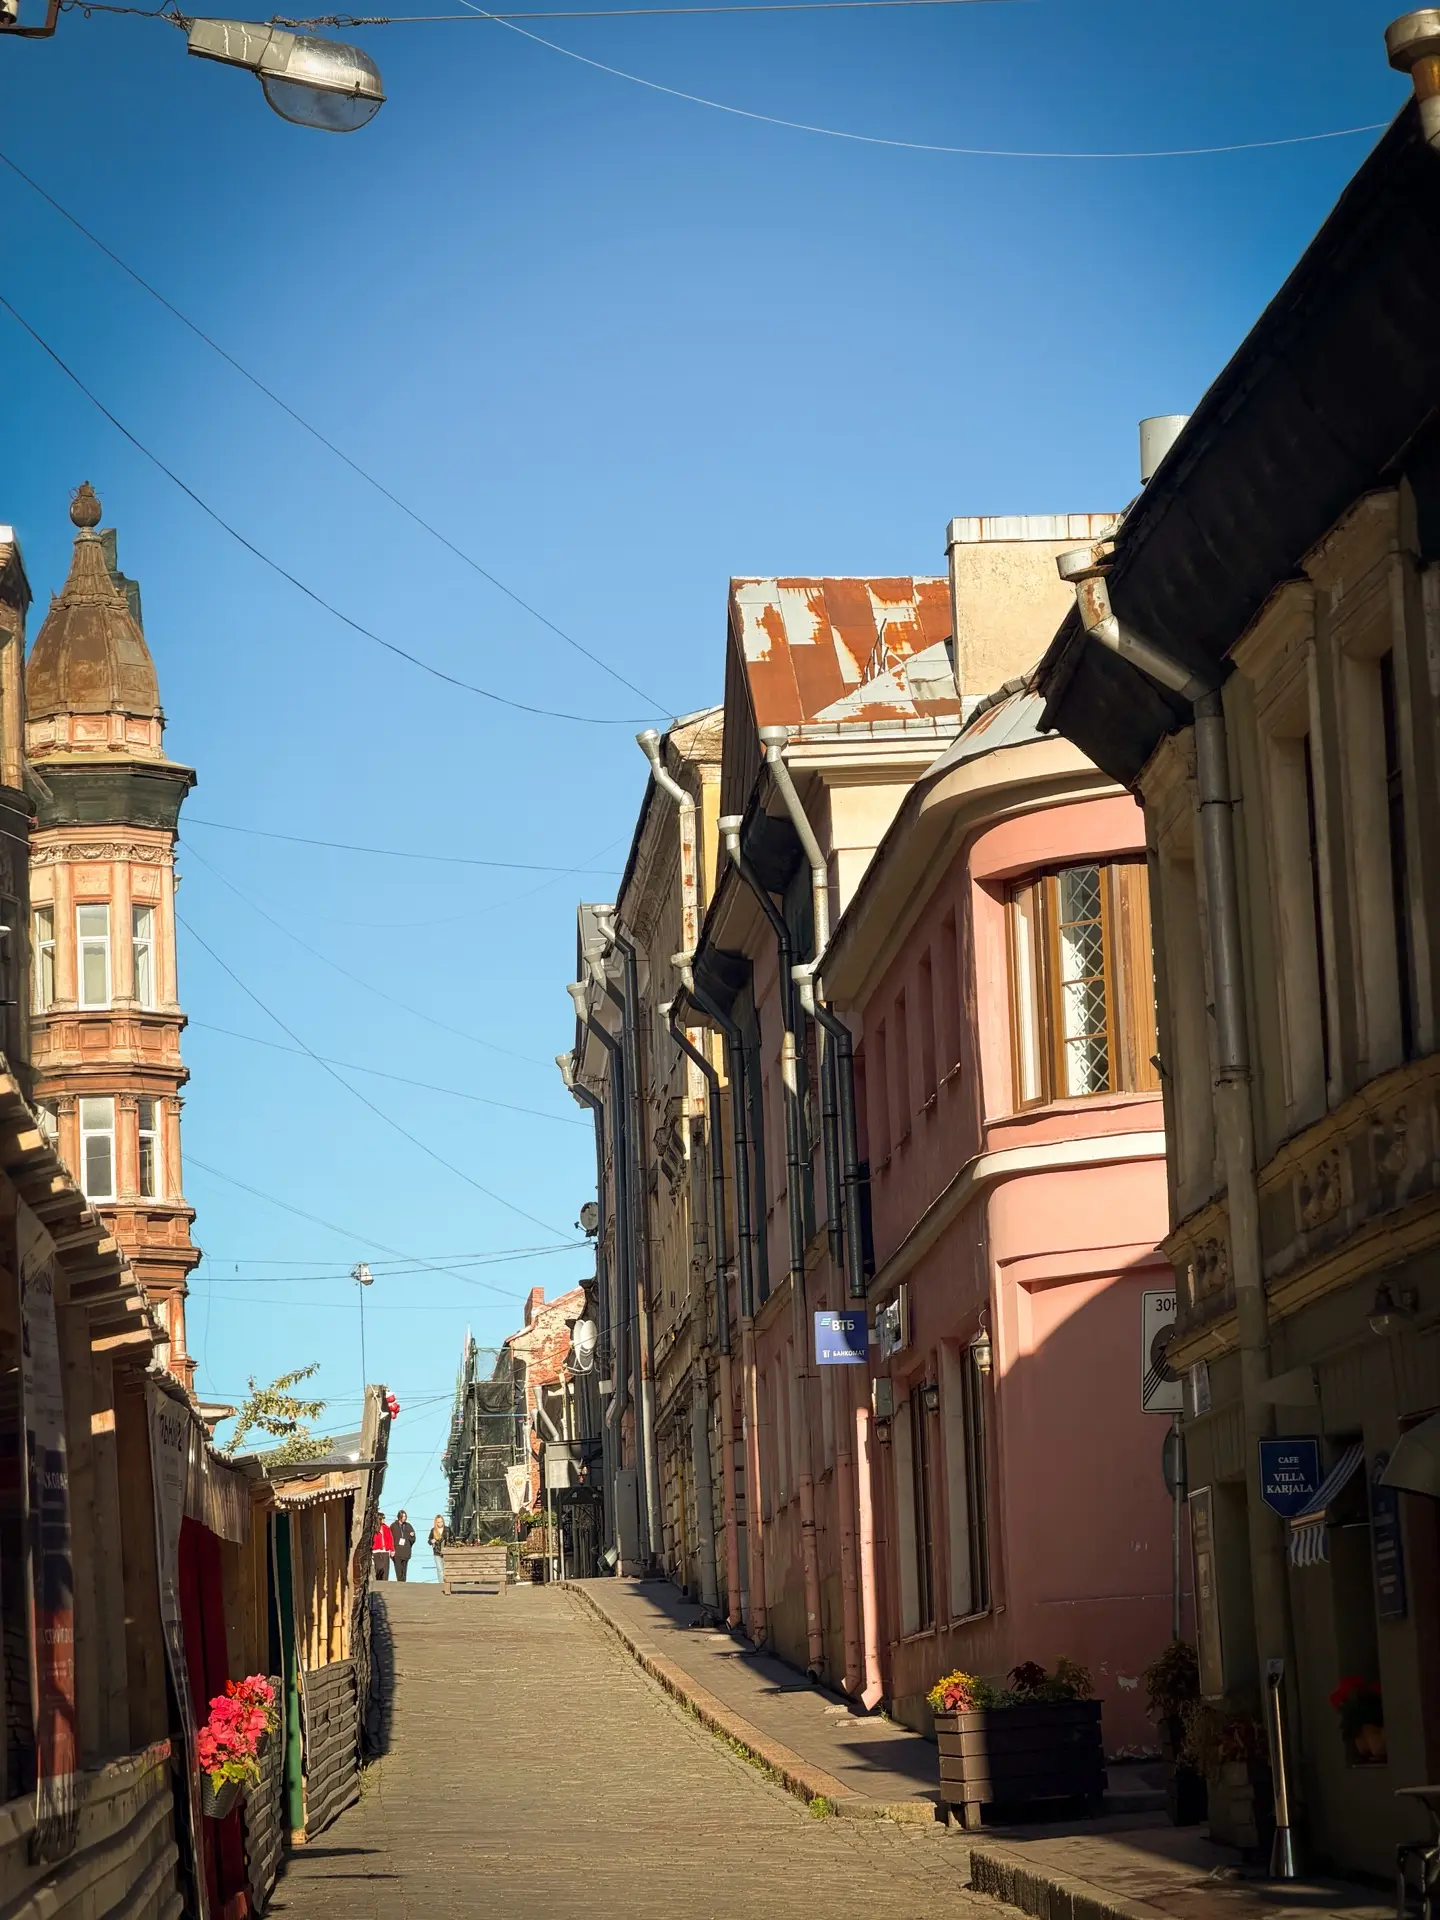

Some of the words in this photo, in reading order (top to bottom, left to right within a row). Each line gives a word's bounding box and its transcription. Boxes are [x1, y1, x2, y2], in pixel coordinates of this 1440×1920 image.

[831, 1319, 855, 1331] ВТБ
[832, 1349, 865, 1357] БАНКОМАТ
[1278, 1456, 1299, 1464] CAFE
[1273, 1472, 1305, 1481] VILLA
[1266, 1484, 1314, 1495] KARJALA
